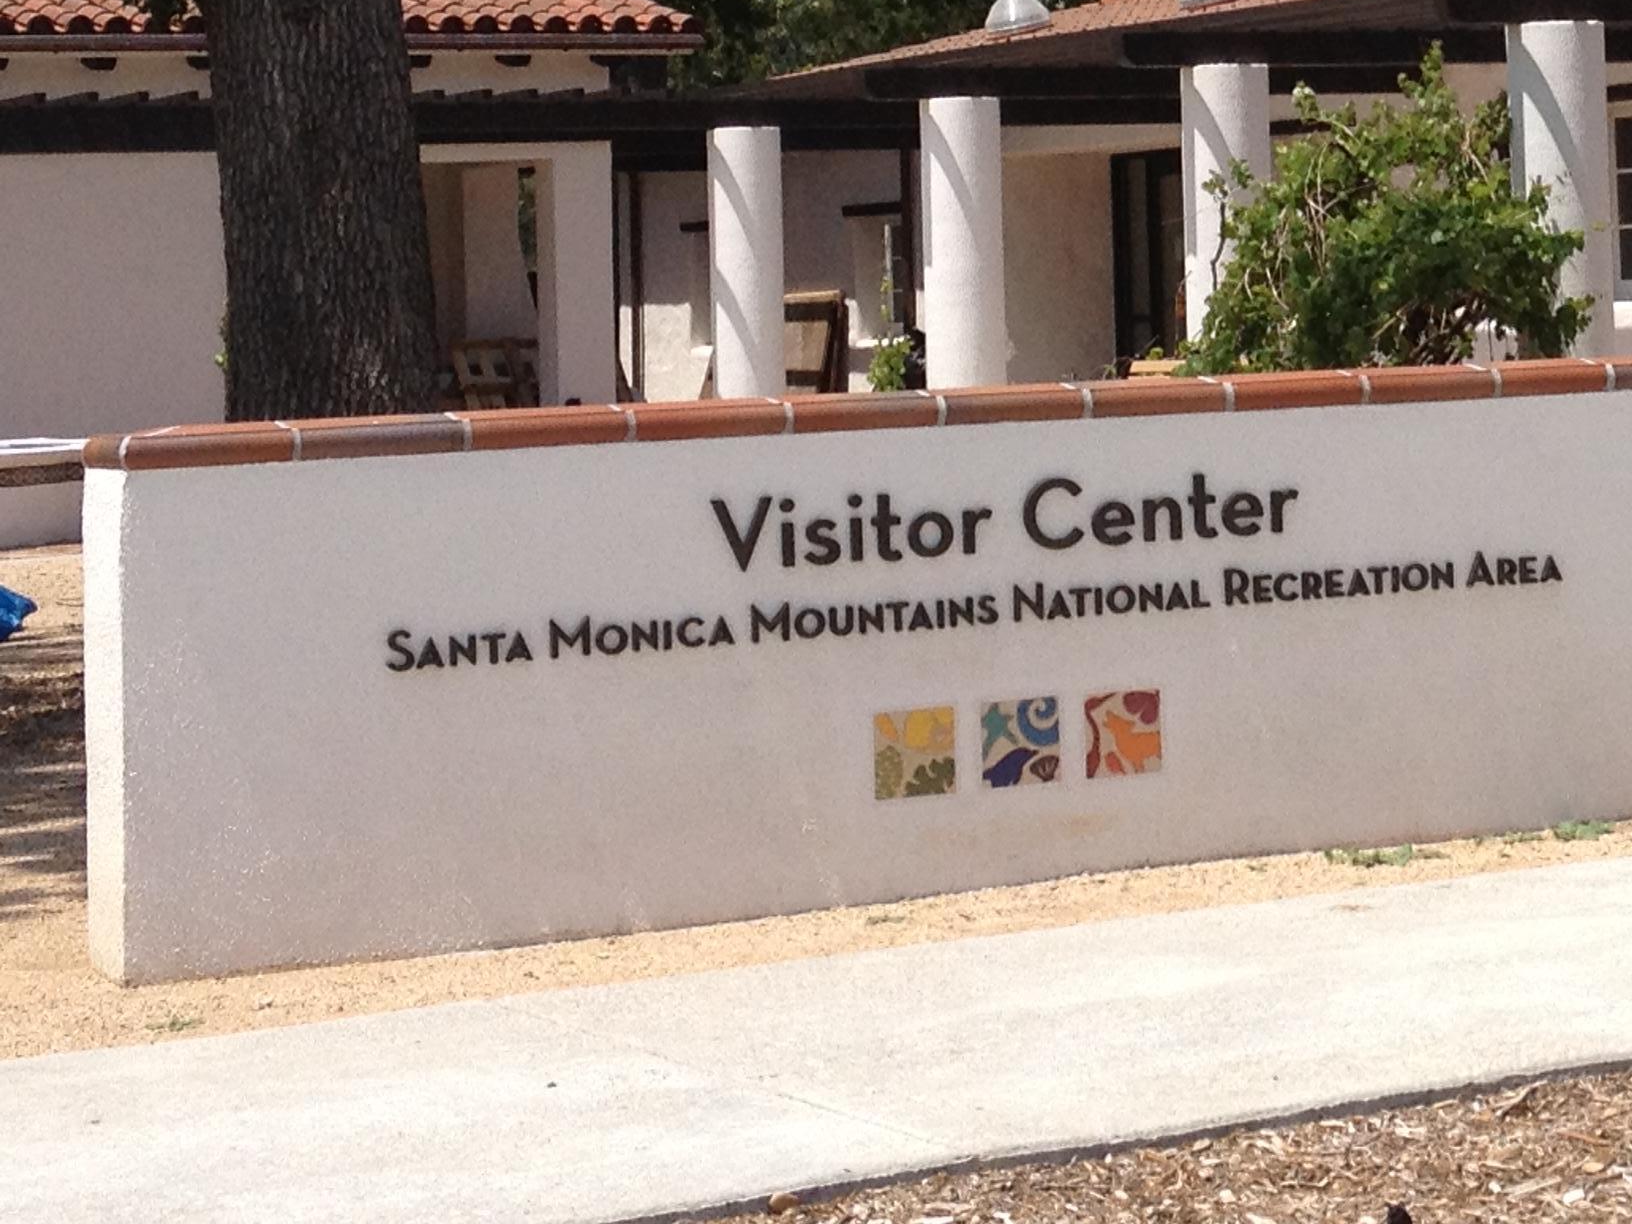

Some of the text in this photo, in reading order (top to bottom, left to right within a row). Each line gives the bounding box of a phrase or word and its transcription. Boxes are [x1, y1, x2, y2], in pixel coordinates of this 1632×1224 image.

[708, 472, 1300, 574] Visitor Center
[384, 550, 1565, 673] SANTA MONICA MOUNTAINS NATIONAL RECREATION AREA
